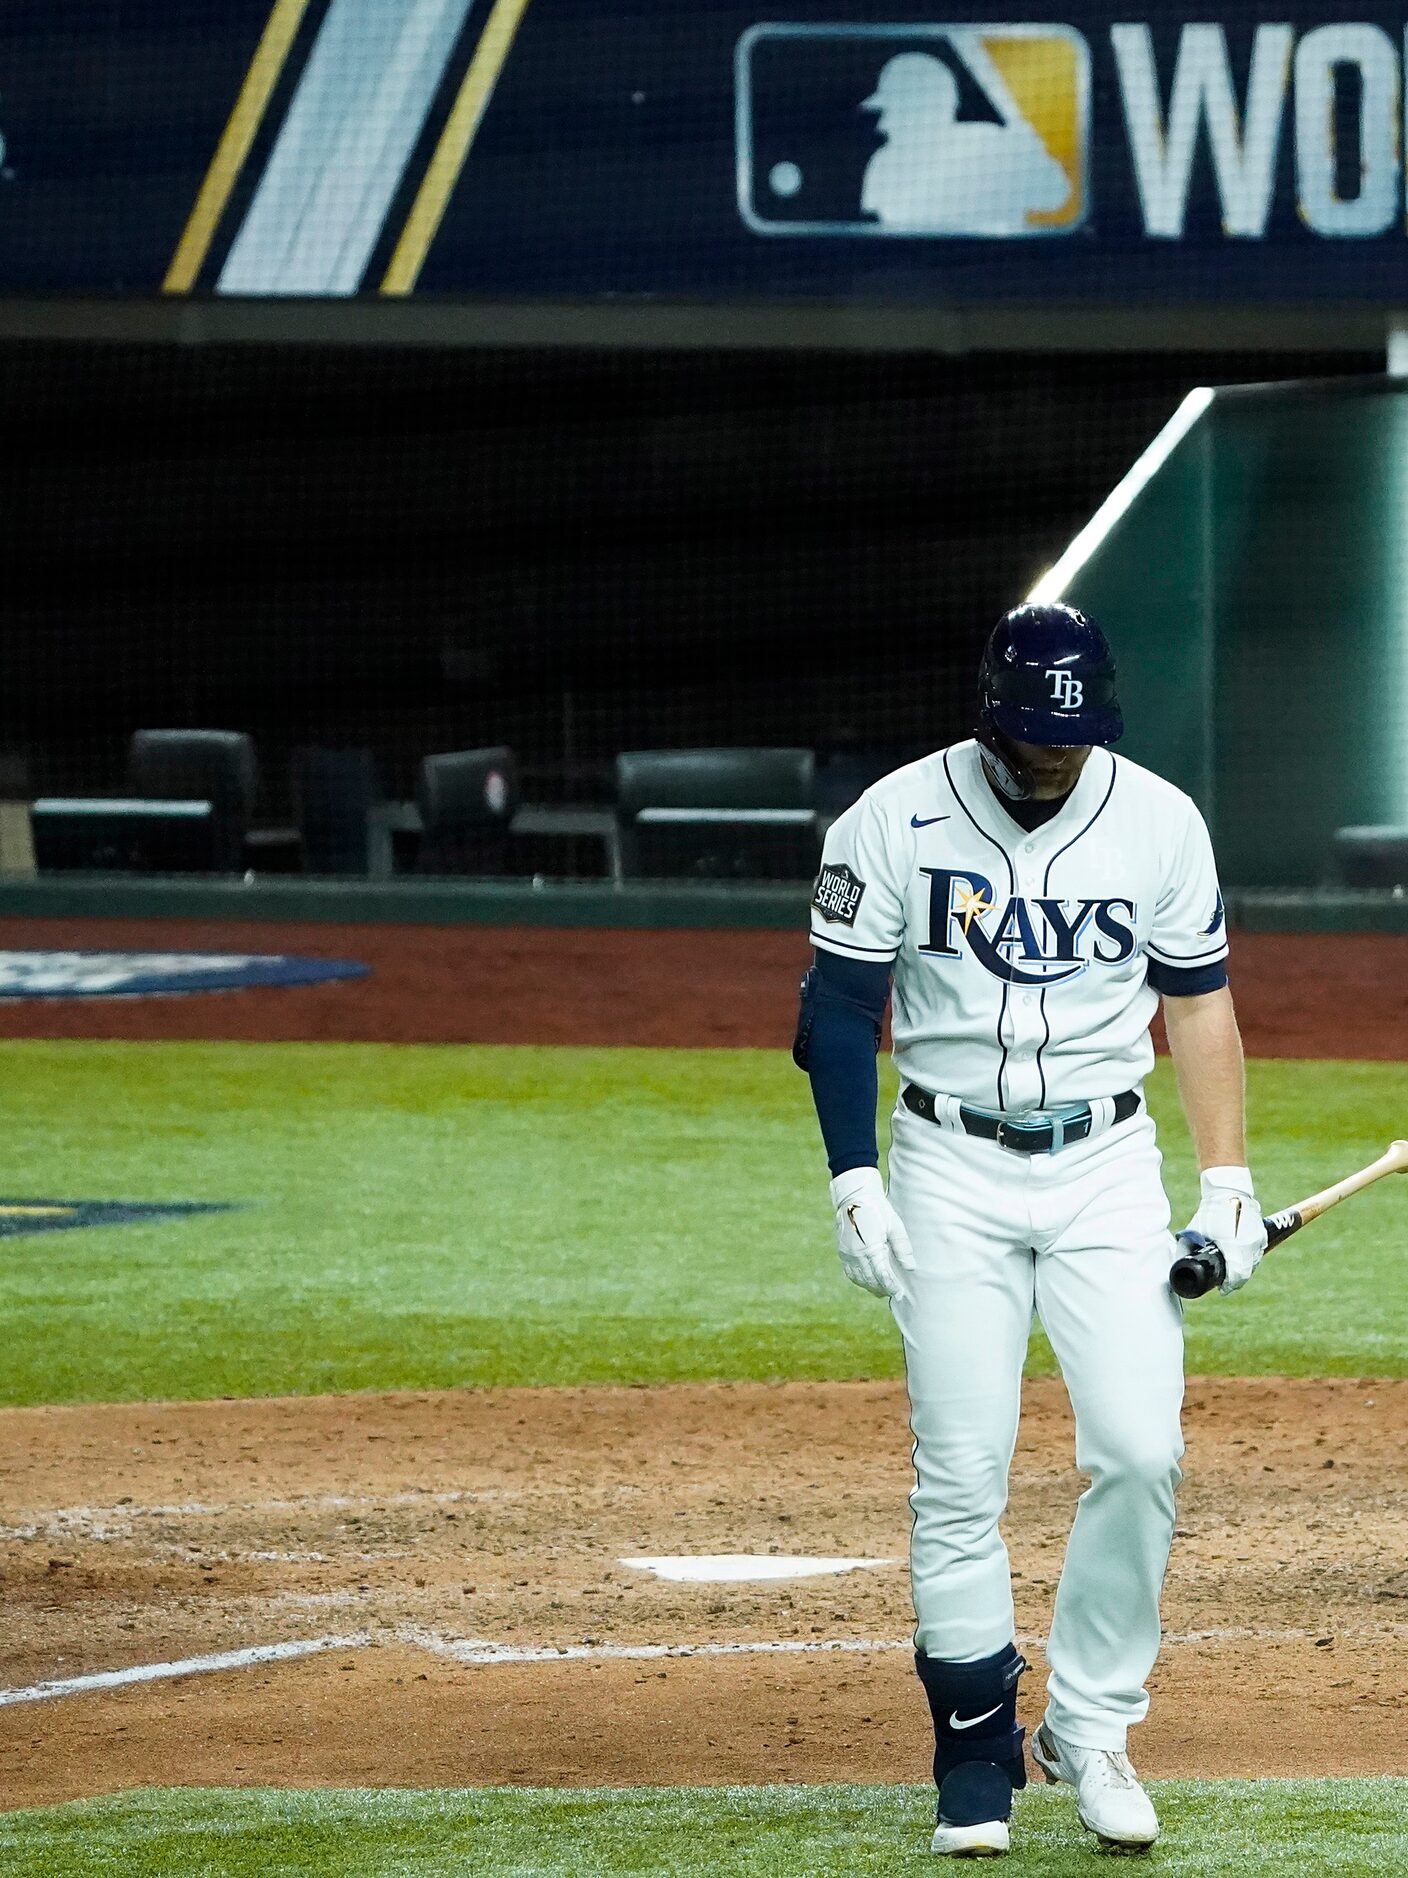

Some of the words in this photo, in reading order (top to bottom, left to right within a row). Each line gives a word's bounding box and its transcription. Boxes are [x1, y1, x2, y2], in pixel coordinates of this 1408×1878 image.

[1045, 669, 1084, 709] TB
[815, 886, 856, 919] SERIES
[821, 870, 861, 903] WORLD
[918, 866, 1137, 988] RAYS
